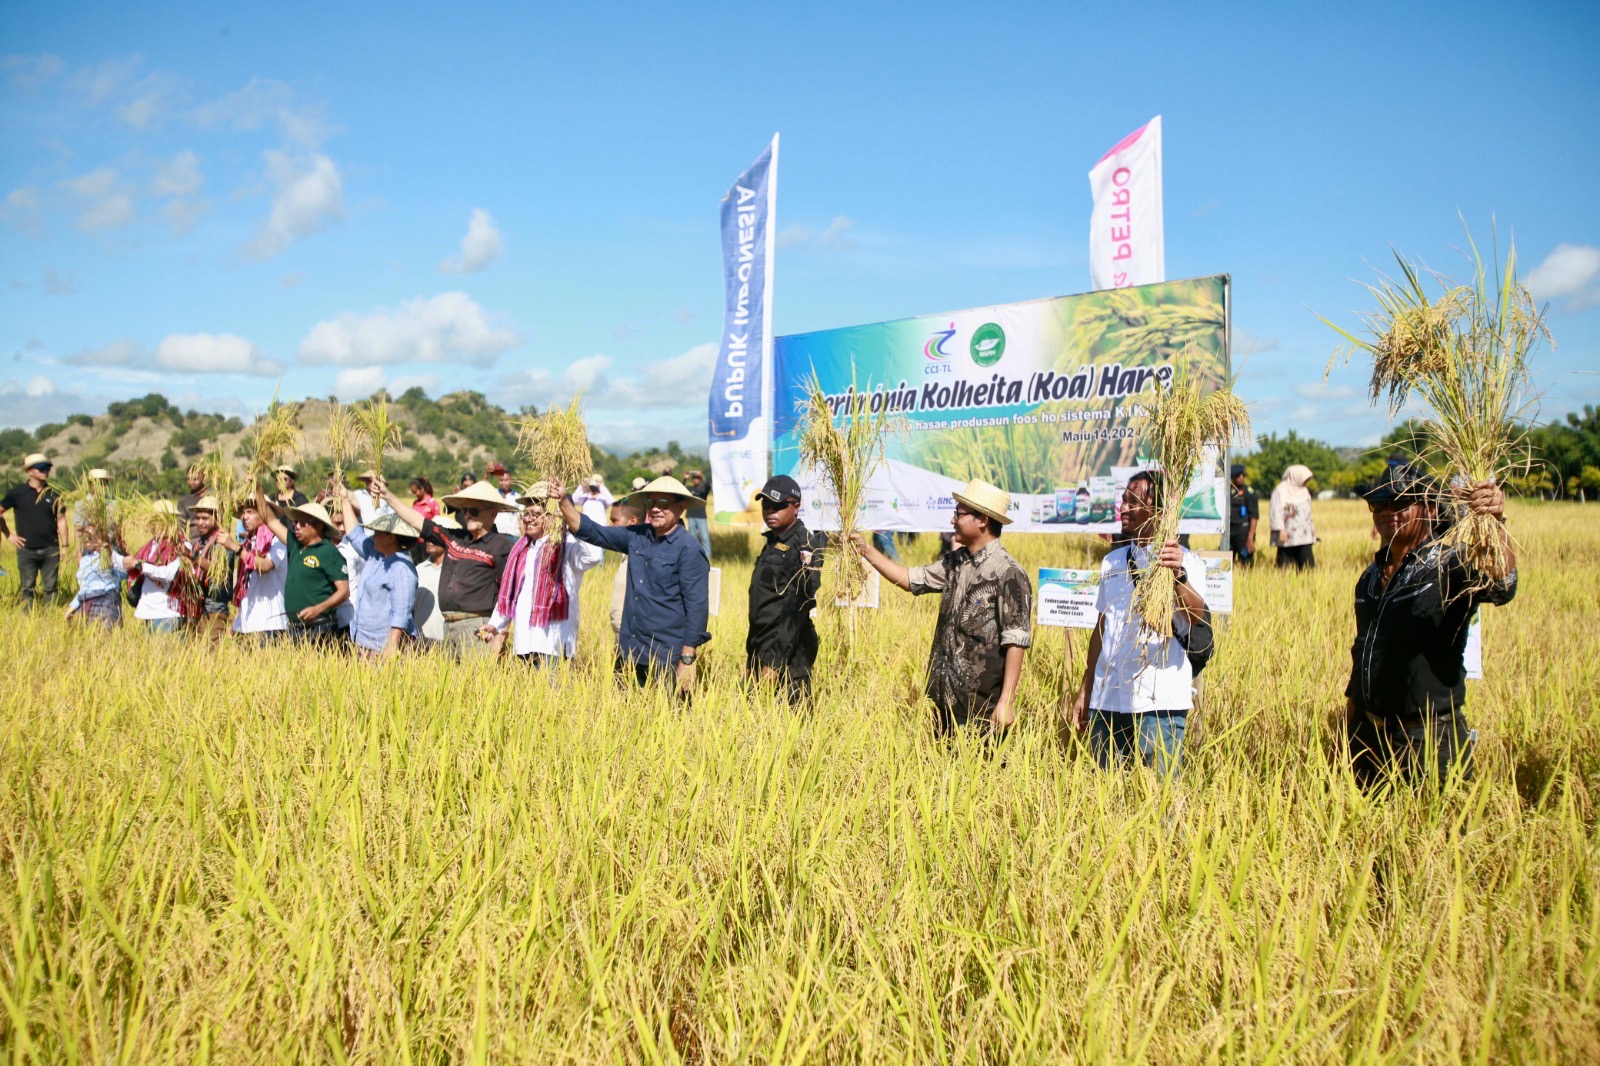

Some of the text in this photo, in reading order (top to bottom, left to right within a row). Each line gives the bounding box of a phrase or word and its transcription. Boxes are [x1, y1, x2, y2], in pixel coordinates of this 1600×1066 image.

[924, 364, 952, 375] CCI-TL
[812, 381, 918, 418] erimónia
[920, 373, 1023, 410] Kolheita
[1027, 365, 1095, 404] (Koá)
[915, 420, 948, 431] hasae
[951, 416, 1010, 431] produsaun
[1012, 413, 1038, 425] foos
[1041, 412, 1056, 422] ho
[1060, 409, 1111, 422] sistema
[1062, 427, 1141, 442] Maiu 14,202
